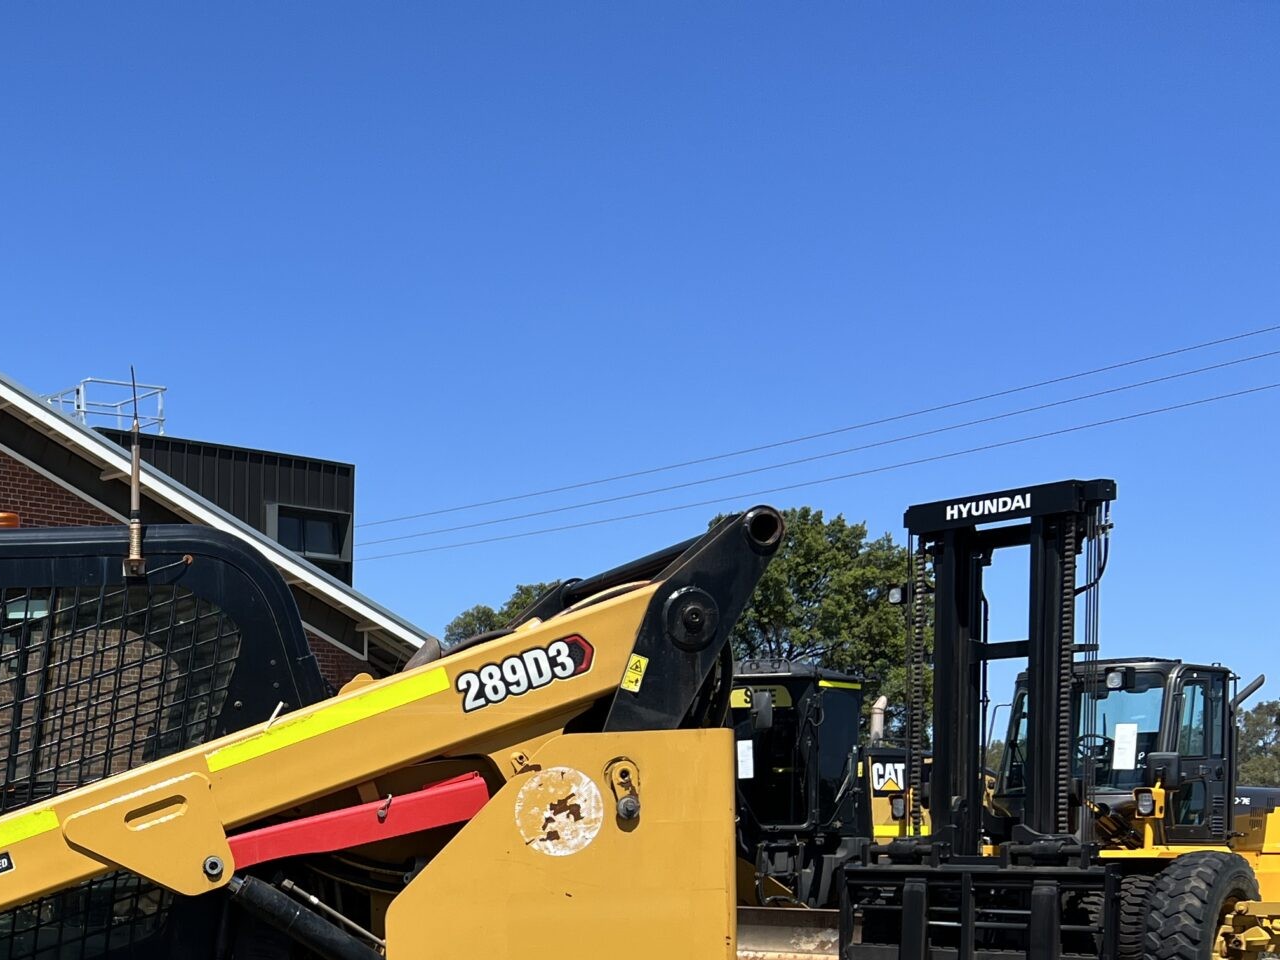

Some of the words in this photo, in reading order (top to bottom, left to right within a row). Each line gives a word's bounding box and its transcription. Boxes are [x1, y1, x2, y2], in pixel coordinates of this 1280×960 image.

[946, 493, 1031, 520] HYUNDAI
[458, 641, 575, 711] 289D3
[872, 762, 905, 790] CAT
